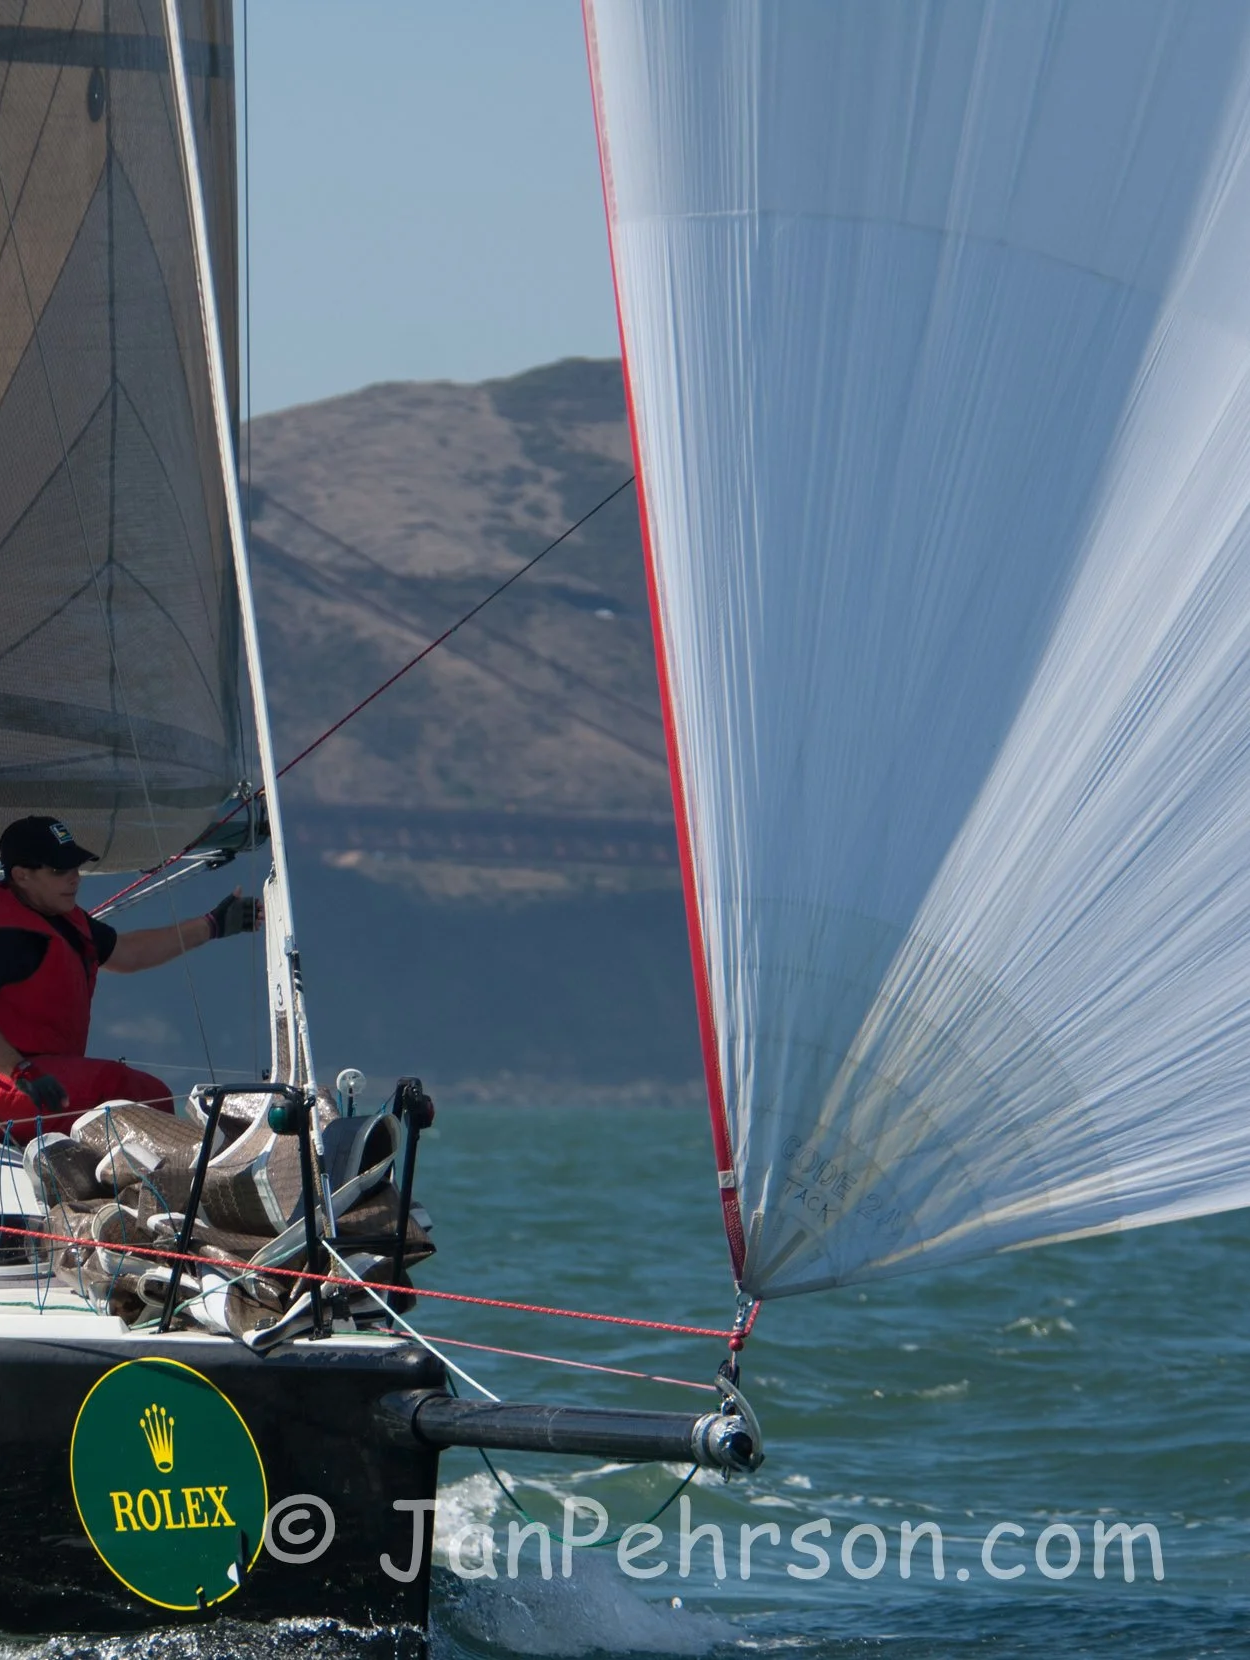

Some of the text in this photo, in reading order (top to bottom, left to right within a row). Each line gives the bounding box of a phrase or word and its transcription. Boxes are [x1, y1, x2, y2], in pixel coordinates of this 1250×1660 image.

[276, 983, 284, 1006] 3
[783, 1136, 856, 1200] CODE
[784, 1177, 838, 1223] TACK
[109, 1486, 236, 1532] ROLEX
